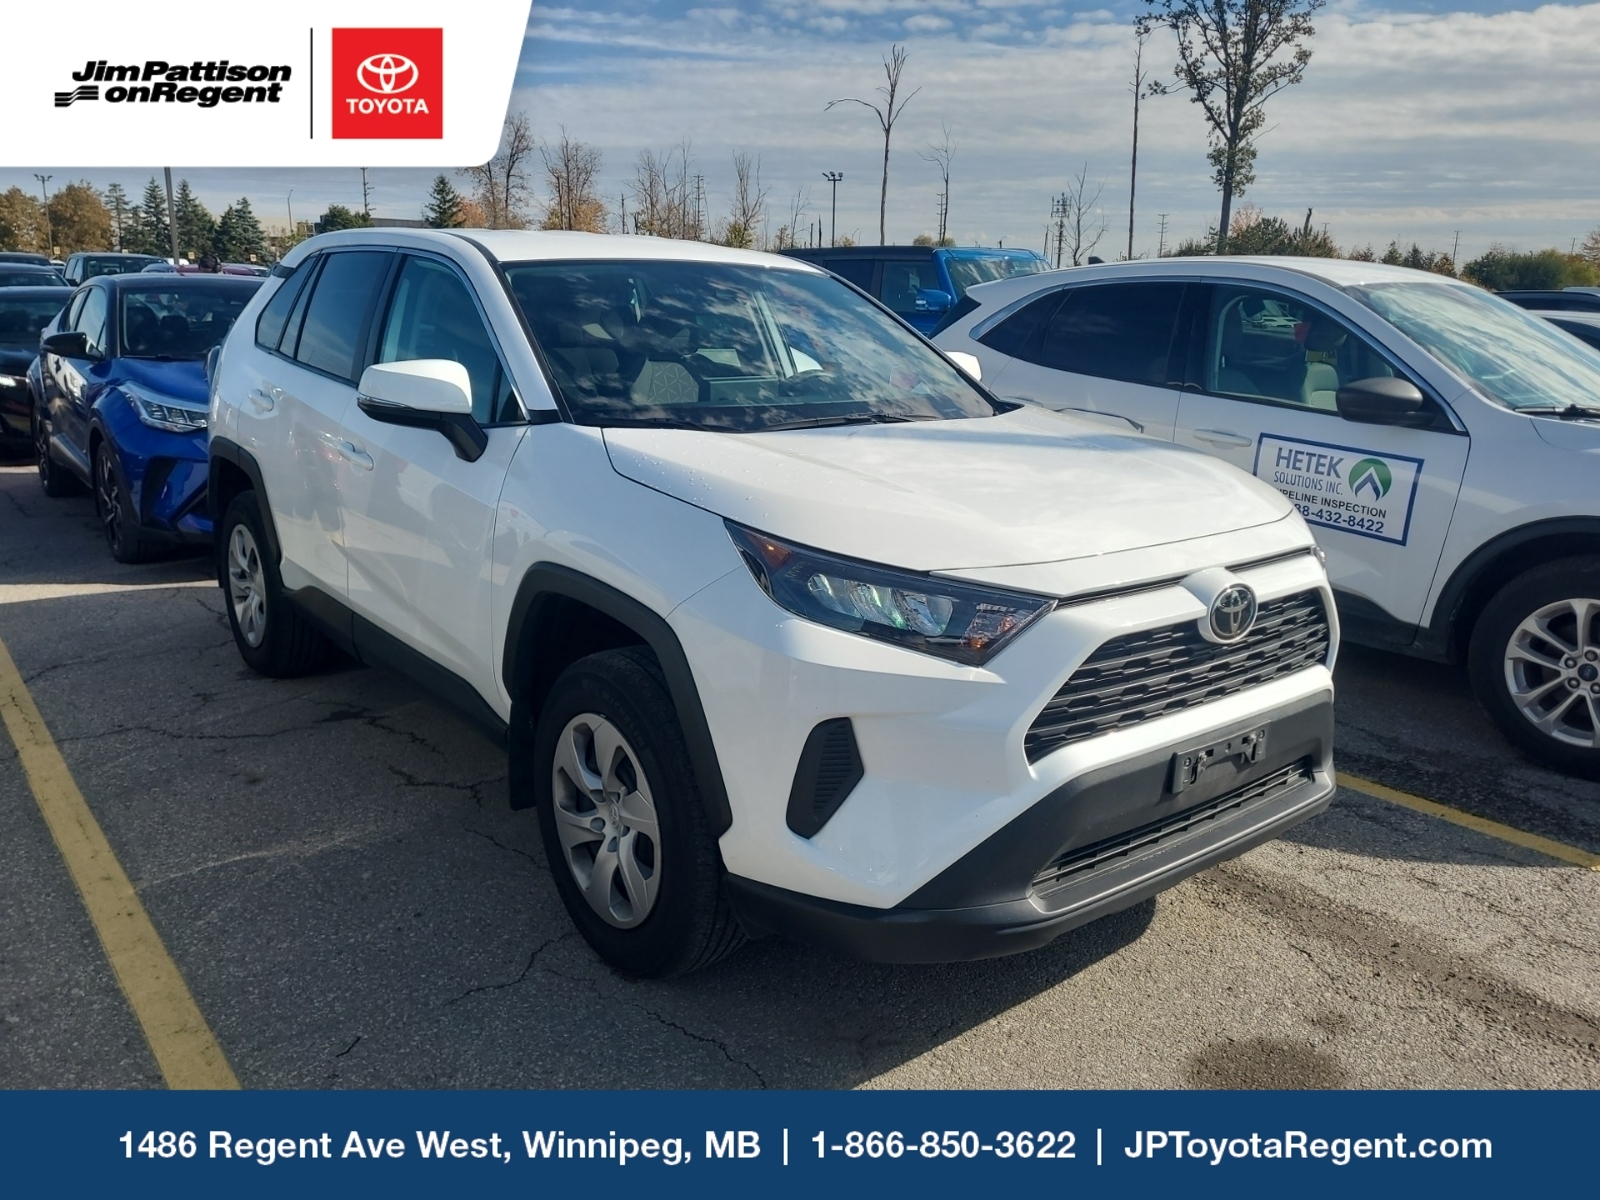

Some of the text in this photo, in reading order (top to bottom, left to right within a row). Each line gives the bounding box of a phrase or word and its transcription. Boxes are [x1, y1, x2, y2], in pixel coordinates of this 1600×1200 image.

[1275, 447, 1345, 479] HETEK
[1274, 471, 1343, 496] SOLUTIONS INC.
[1320, 497, 1387, 519] INSPECTION
